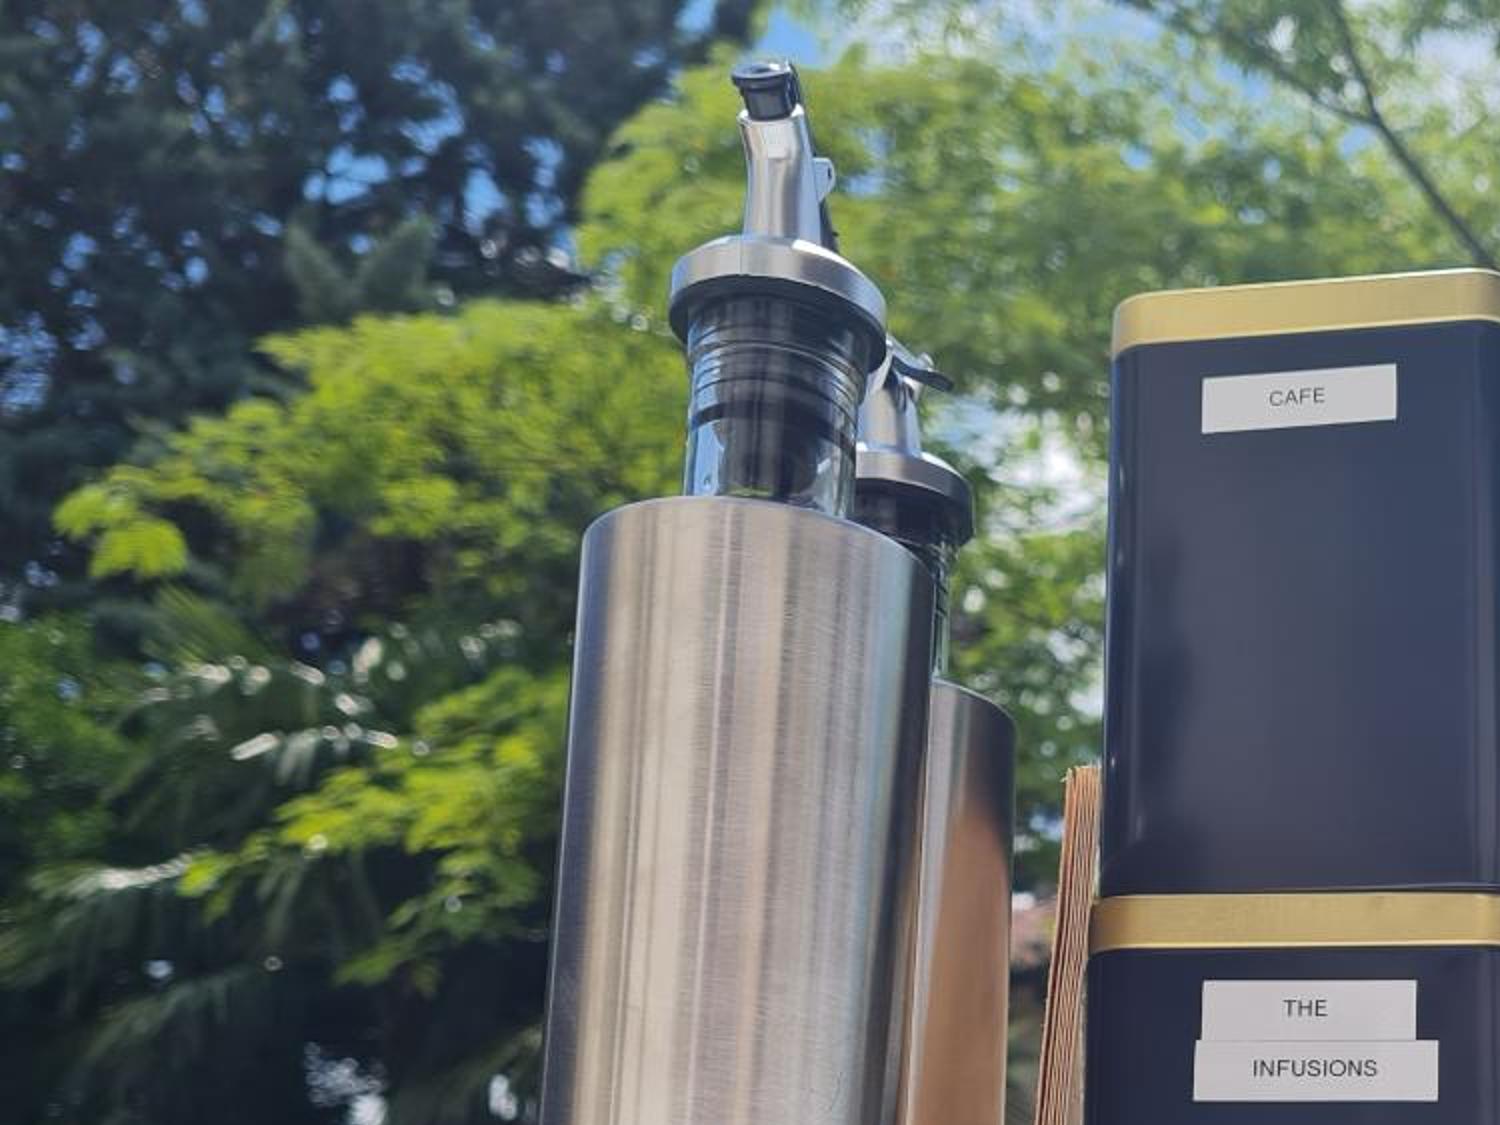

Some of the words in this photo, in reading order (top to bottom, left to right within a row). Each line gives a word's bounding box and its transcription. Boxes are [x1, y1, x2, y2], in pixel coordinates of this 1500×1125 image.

[1268, 386, 1326, 407] CAFE
[1283, 999, 1329, 1017] THE
[1253, 1059, 1379, 1078] INFUSIONS
